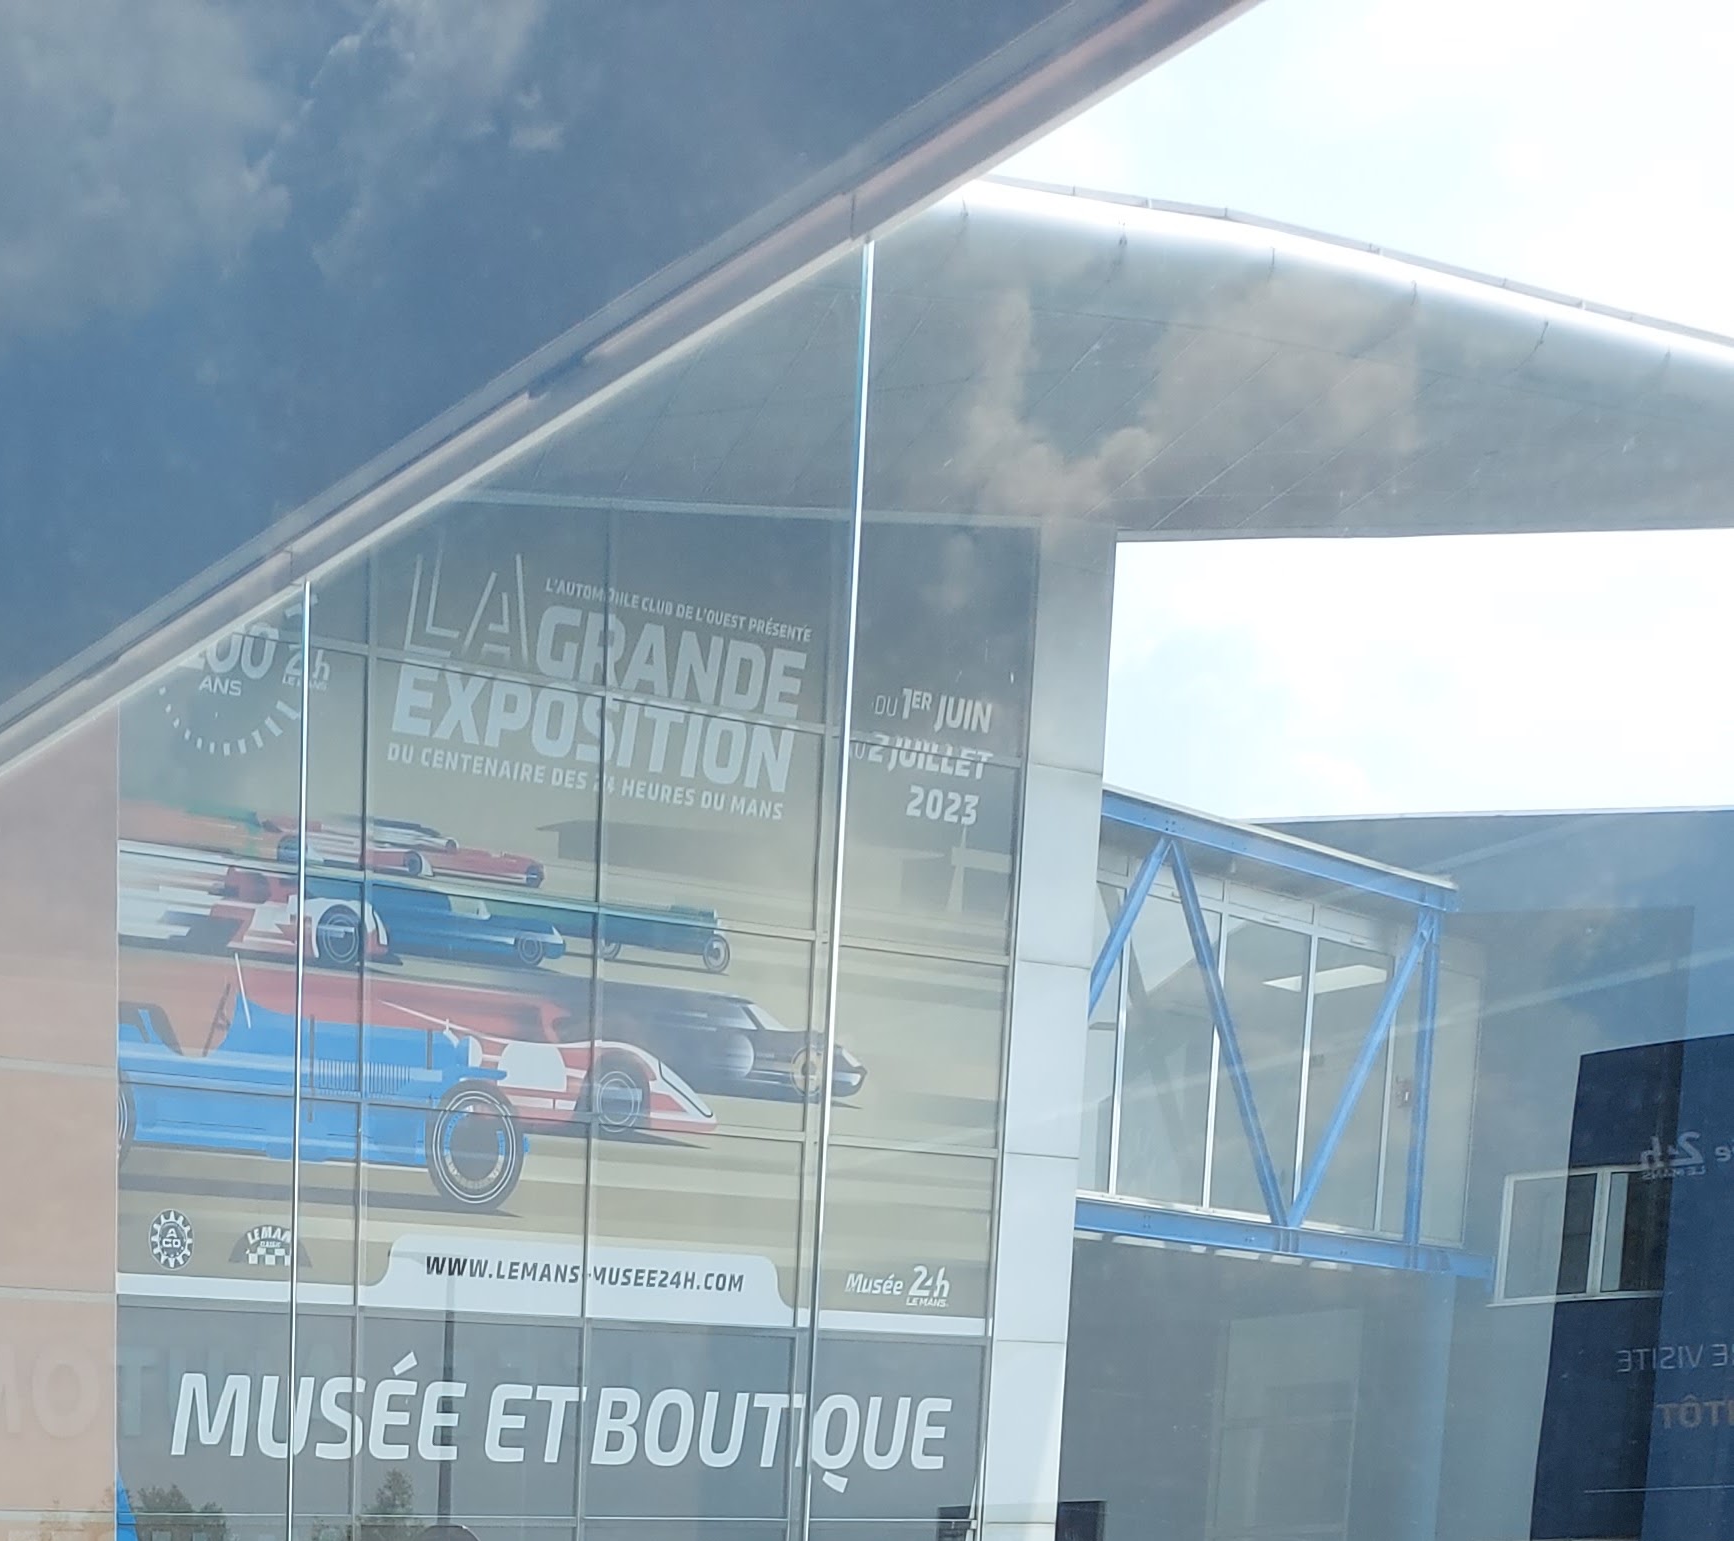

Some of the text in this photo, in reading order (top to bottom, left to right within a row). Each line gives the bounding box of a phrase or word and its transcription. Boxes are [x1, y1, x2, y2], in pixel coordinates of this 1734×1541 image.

[405, 551, 531, 664] LA
[181, 624, 280, 680] 00
[535, 605, 808, 718] GRANDE
[198, 676, 243, 697] ANS
[873, 694, 899, 718] DU
[933, 694, 993, 735] JUIN
[390, 658, 797, 794] EXPOSITION
[386, 741, 415, 764] DU
[419, 745, 547, 787] CENTENAIRE
[551, 765, 589, 792] DES
[620, 777, 697, 811] HEURES
[700, 787, 728, 814] DU
[729, 792, 785, 821] MANS
[887, 735, 994, 780] JUILLET
[905, 784, 980, 826] 2023
[844, 1272, 904, 1296] Musée
[170, 1350, 469, 1463] MUSÉE
[484, 1384, 588, 1464] ET
[590, 1386, 954, 1495] BOUTIQUE
